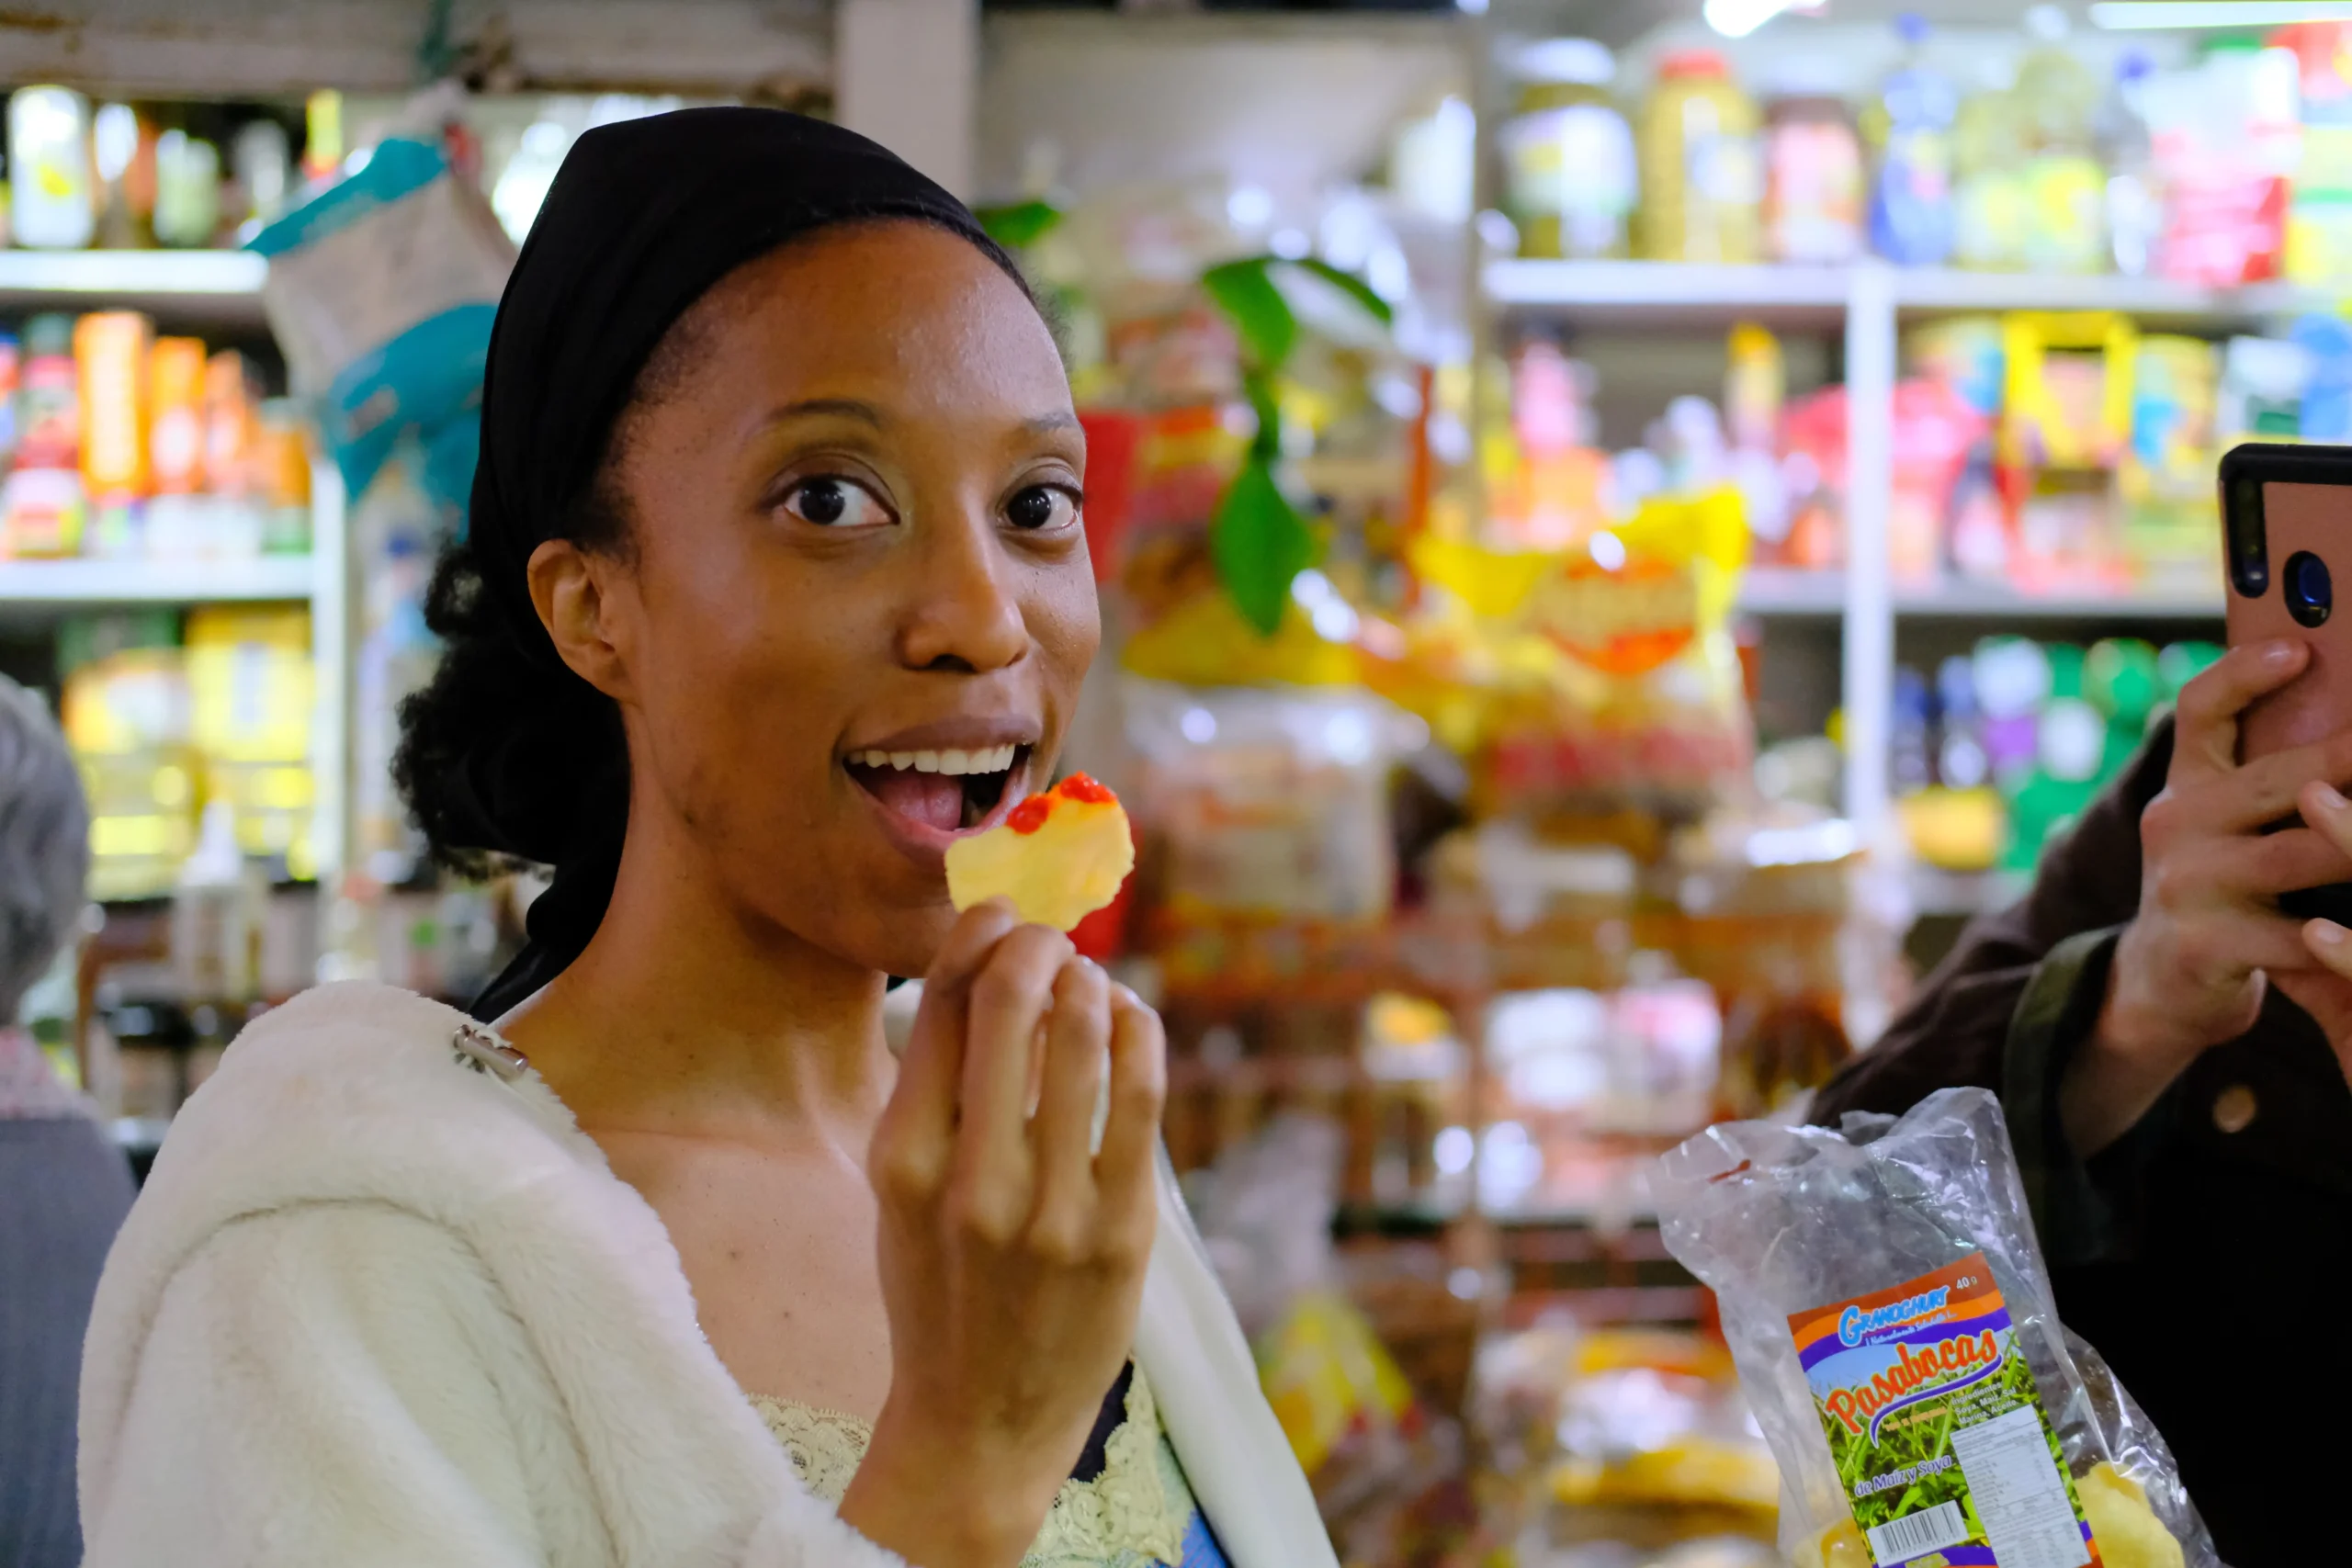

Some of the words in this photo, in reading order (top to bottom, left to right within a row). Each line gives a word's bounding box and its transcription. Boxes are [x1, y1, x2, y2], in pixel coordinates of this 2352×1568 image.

[1956, 1276, 1970, 1290] 40
[1825, 1329, 1997, 1435] Pasabocas
[1854, 1481, 1873, 1497] de
[1905, 1466, 1917, 1485] y
[1917, 1454, 1952, 1476] Soya
